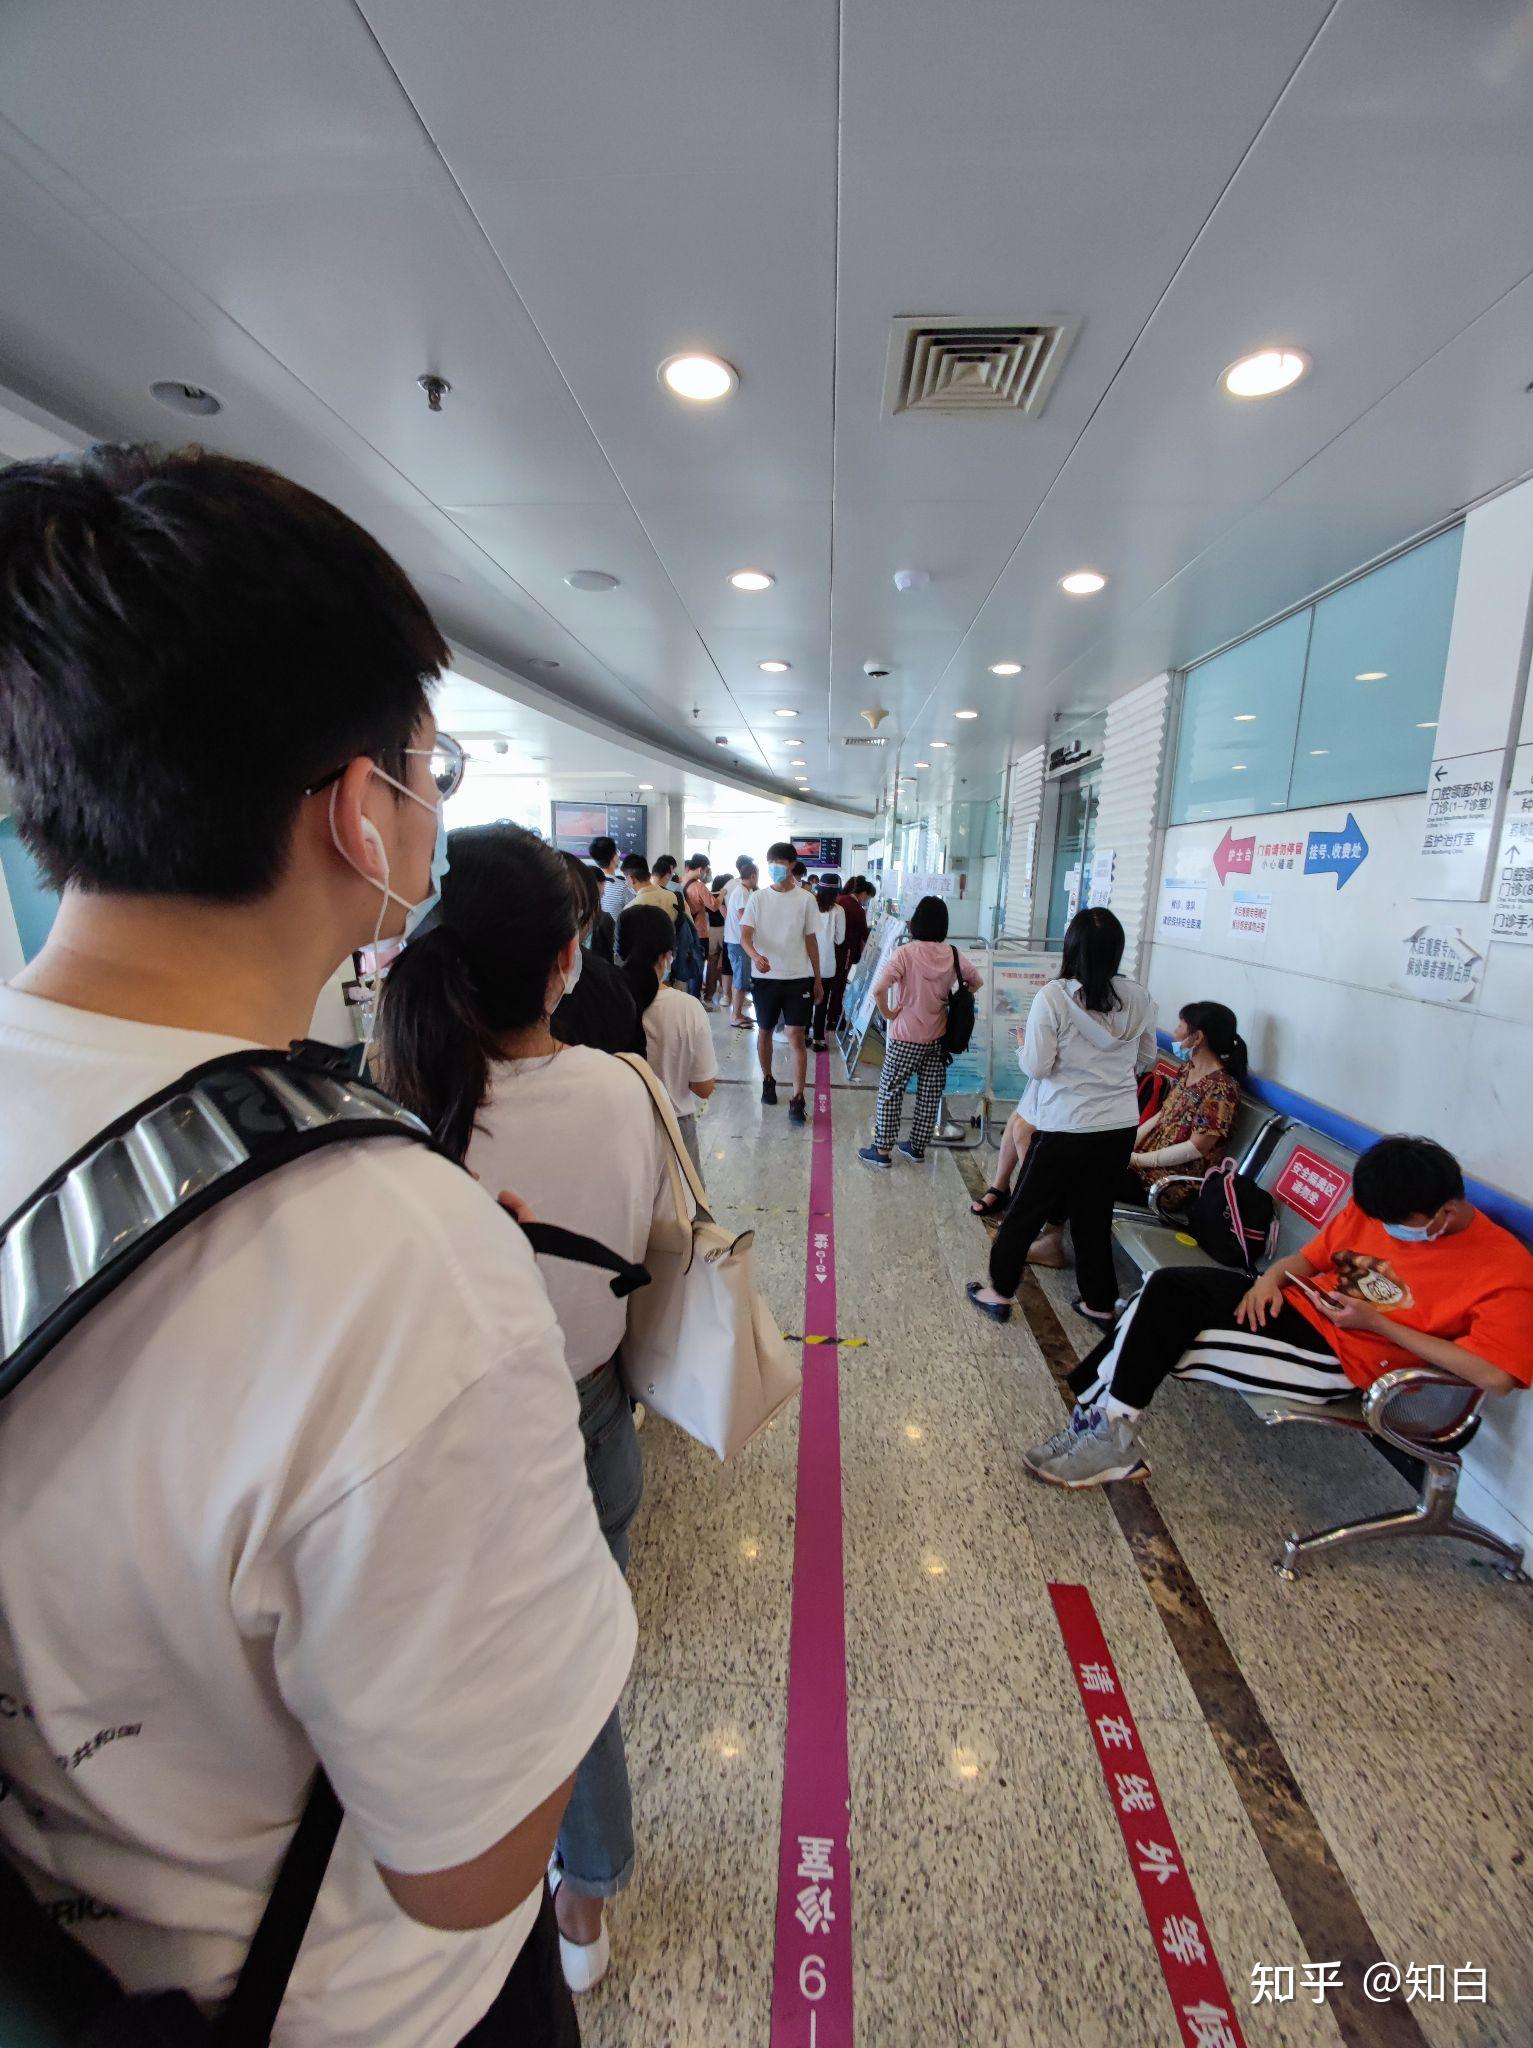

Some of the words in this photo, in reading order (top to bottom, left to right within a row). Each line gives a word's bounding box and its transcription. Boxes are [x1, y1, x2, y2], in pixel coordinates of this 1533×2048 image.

[1257, 842, 1304, 857] 门前请勿停留
[1308, 842, 1362, 860] 挂号、收费处
[1079, 1662, 1236, 2048] 请在线外等候
